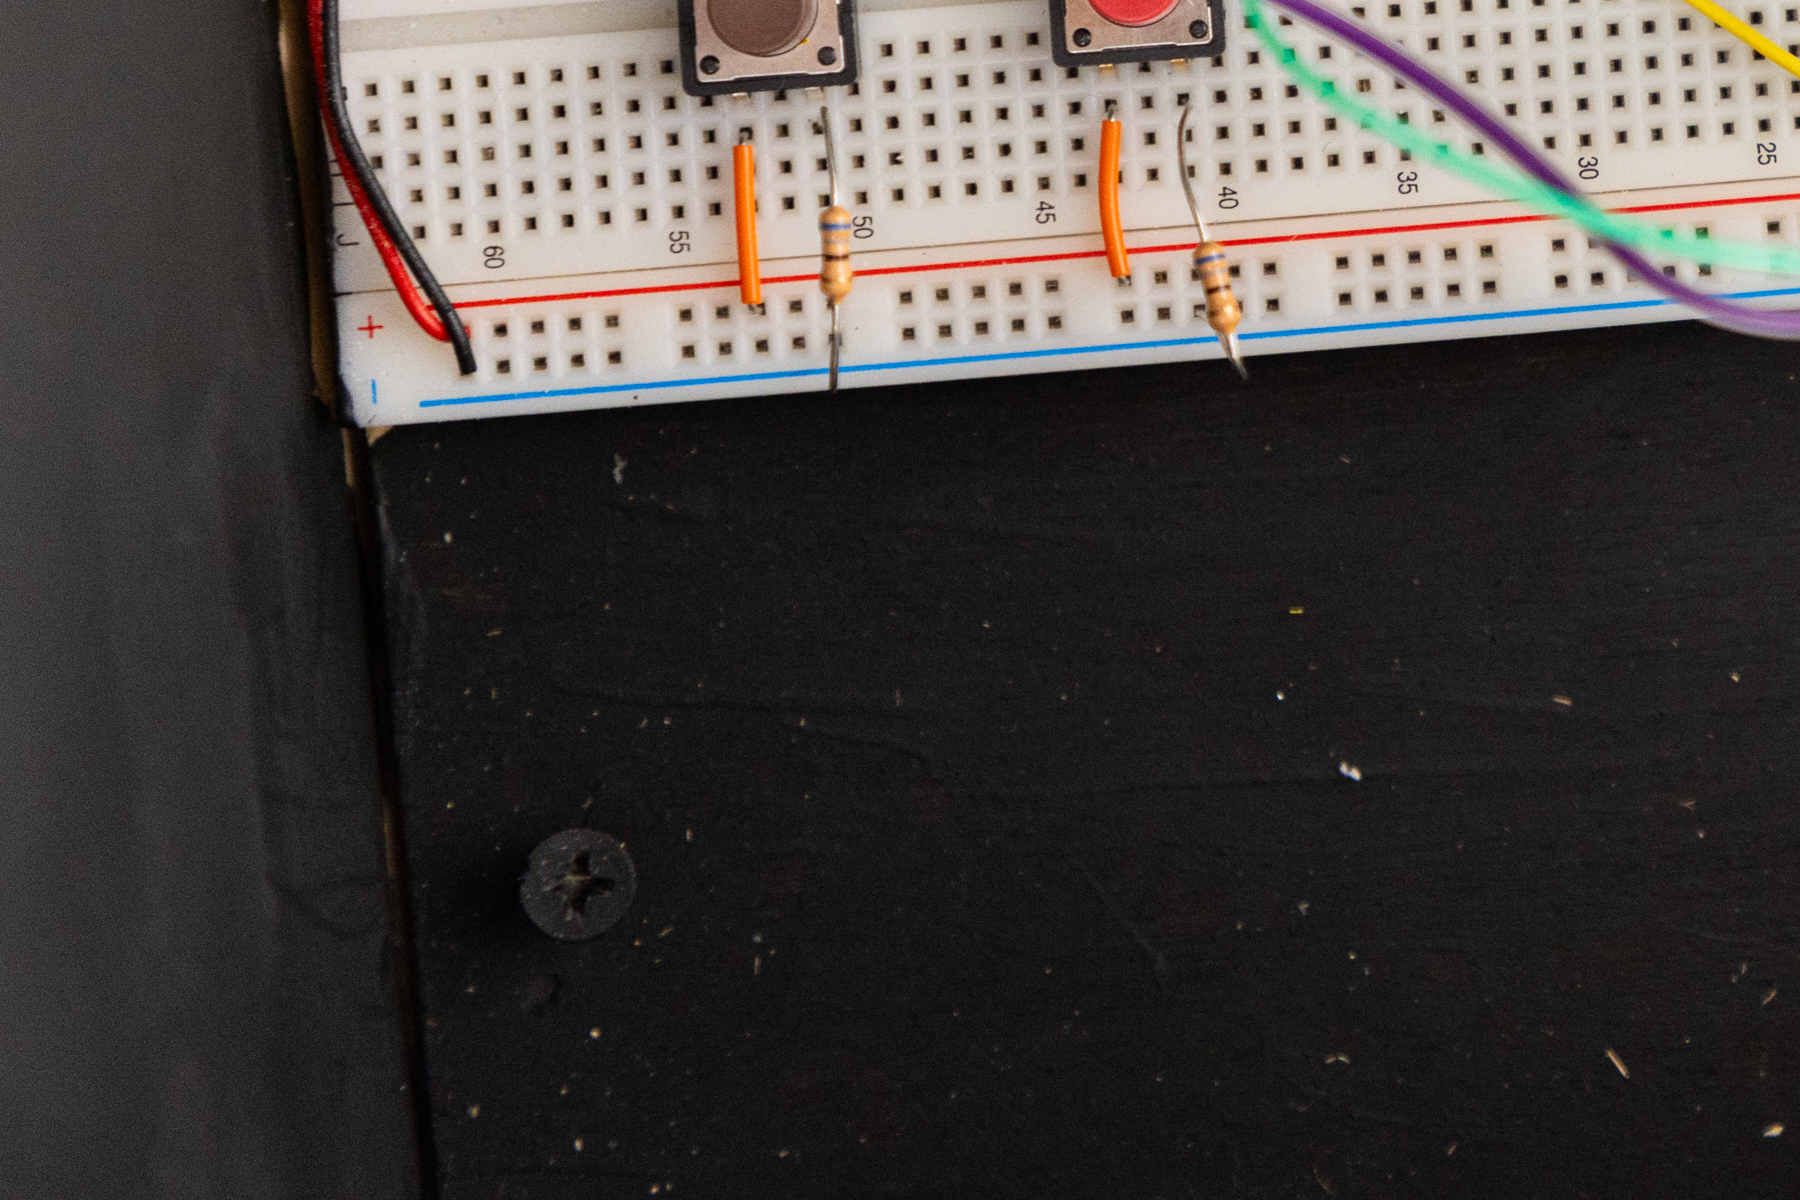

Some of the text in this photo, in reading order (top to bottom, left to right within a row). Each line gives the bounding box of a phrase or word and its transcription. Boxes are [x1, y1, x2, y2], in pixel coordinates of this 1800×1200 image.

[1757, 142, 1777, 165] 25
[1578, 157, 1599, 179] 30
[1397, 172, 1418, 194] 35
[1218, 186, 1239, 209] 40
[1036, 201, 1056, 224] 45
[852, 216, 874, 239] 50
[669, 231, 690, 254] 55
[483, 246, 505, 269] 60
